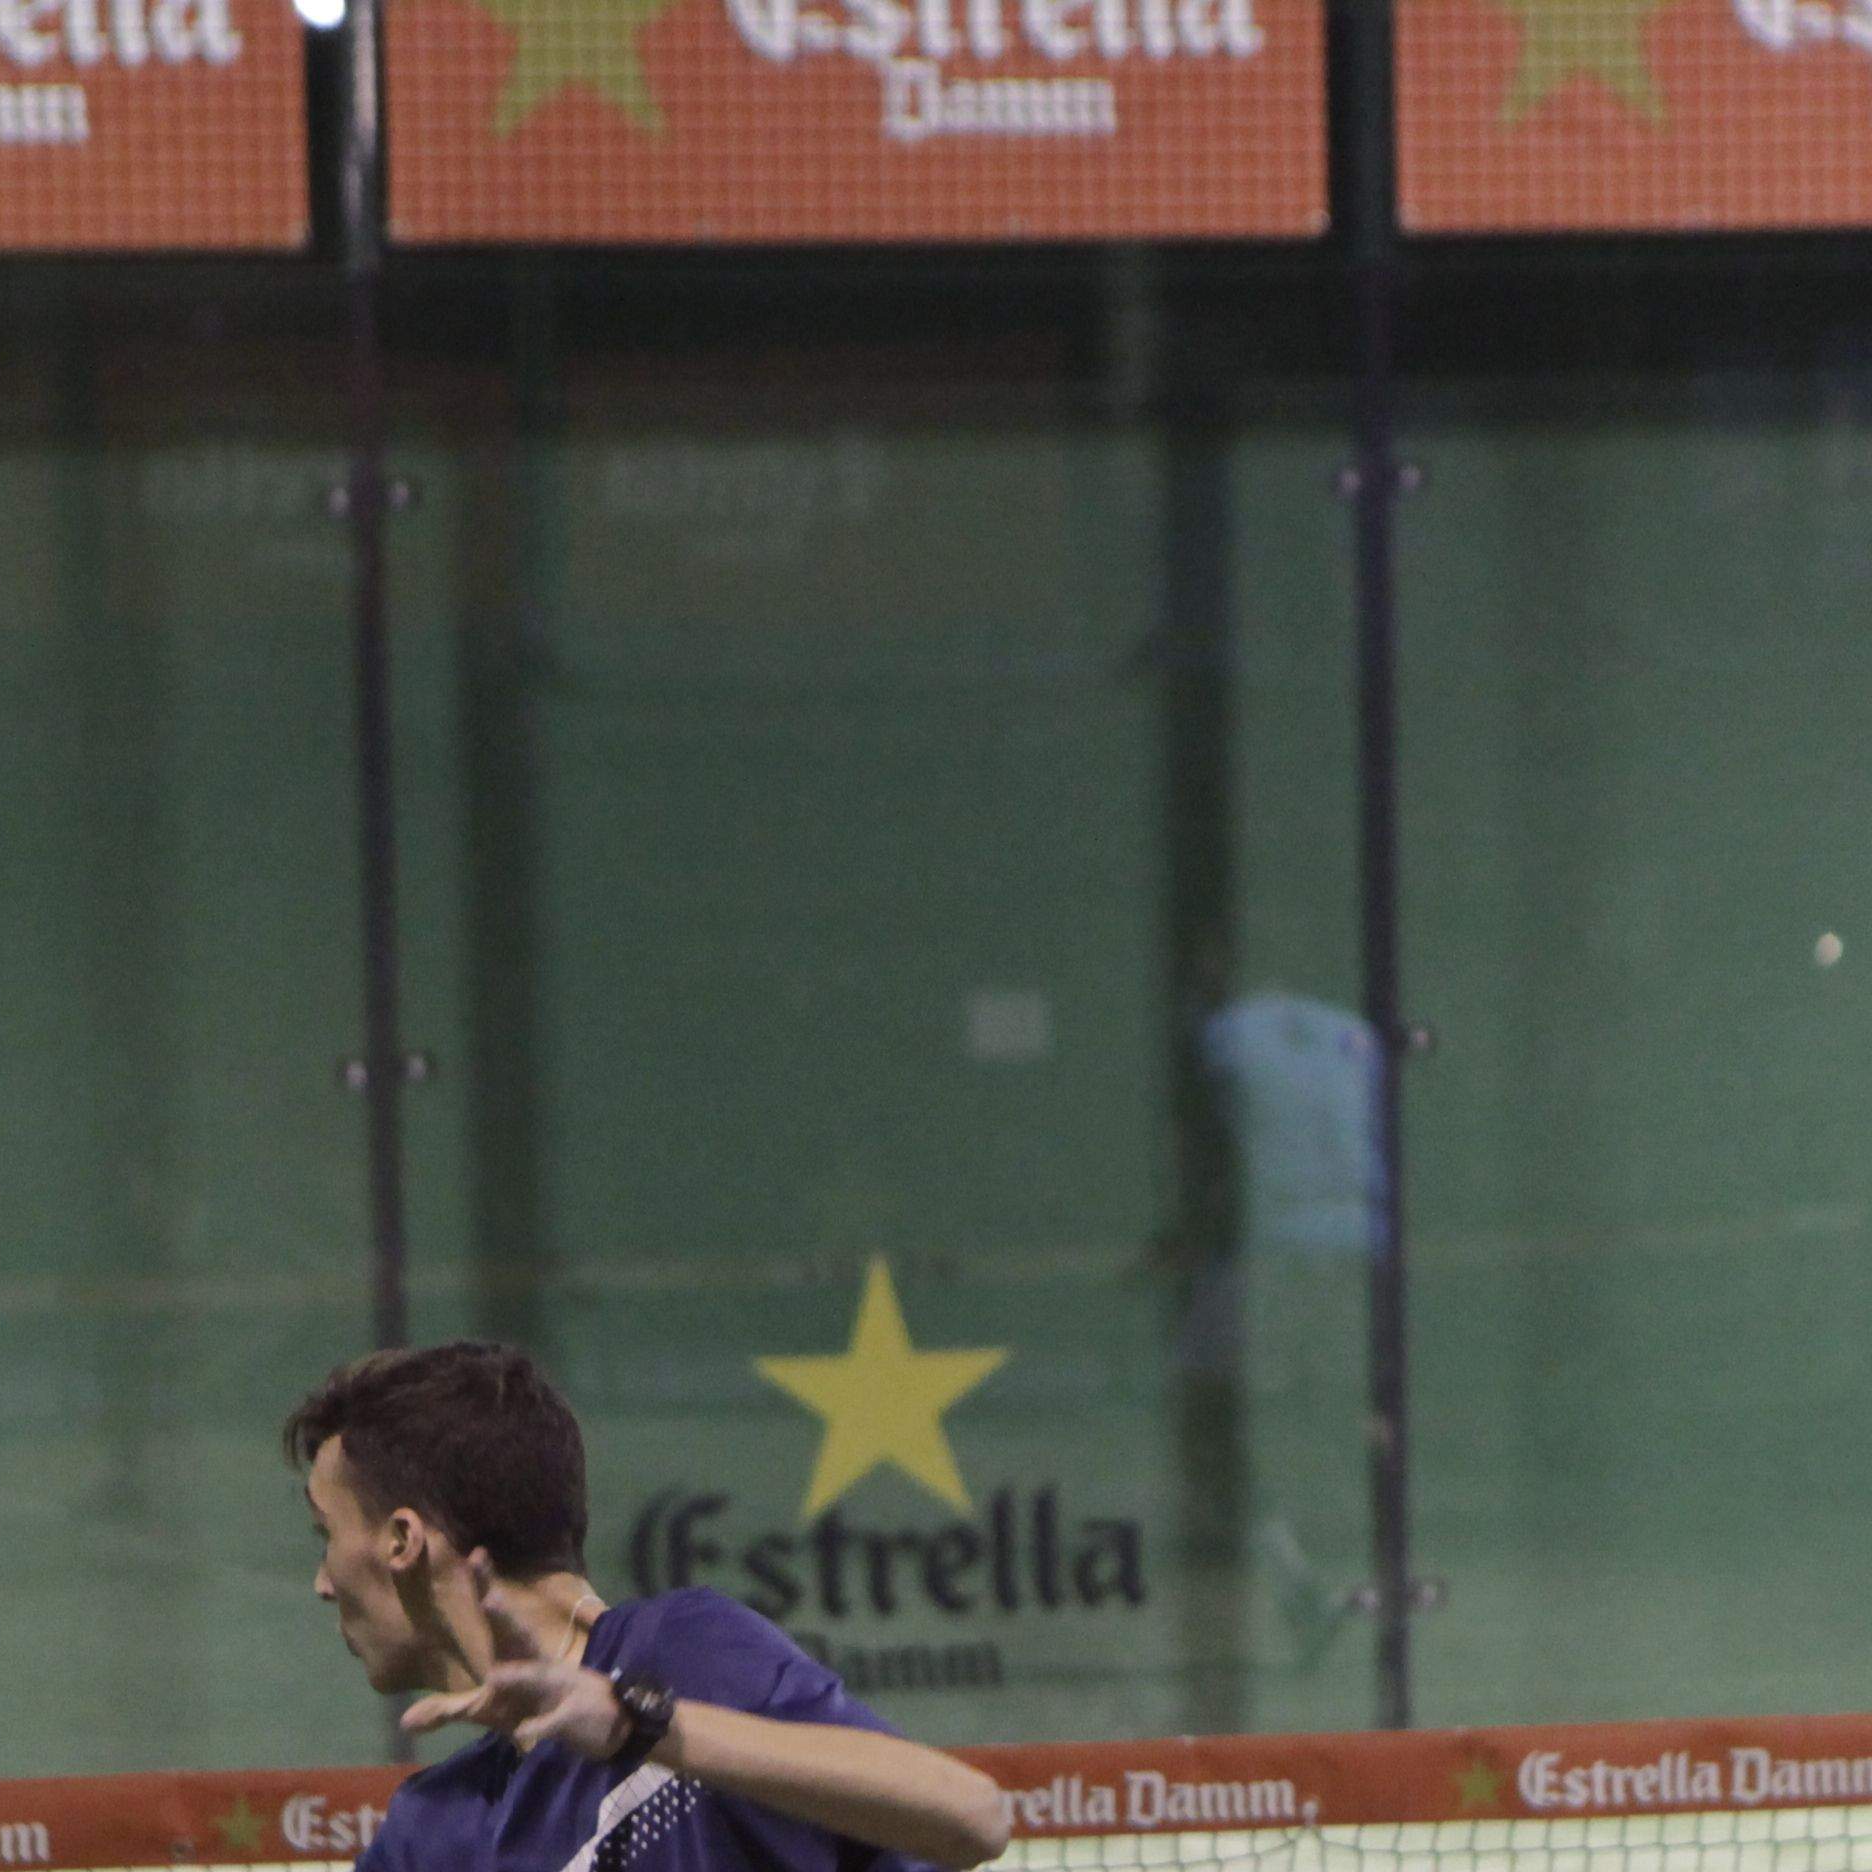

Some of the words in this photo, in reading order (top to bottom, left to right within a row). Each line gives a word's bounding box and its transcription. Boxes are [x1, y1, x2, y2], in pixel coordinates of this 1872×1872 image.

[882, 54, 1116, 142] Damm
[629, 1482, 1146, 1619] Estrella
[998, 1773, 1118, 1828] rella
[1125, 1769, 1297, 1829] Damm
[1517, 1748, 1722, 1808] Estrella
